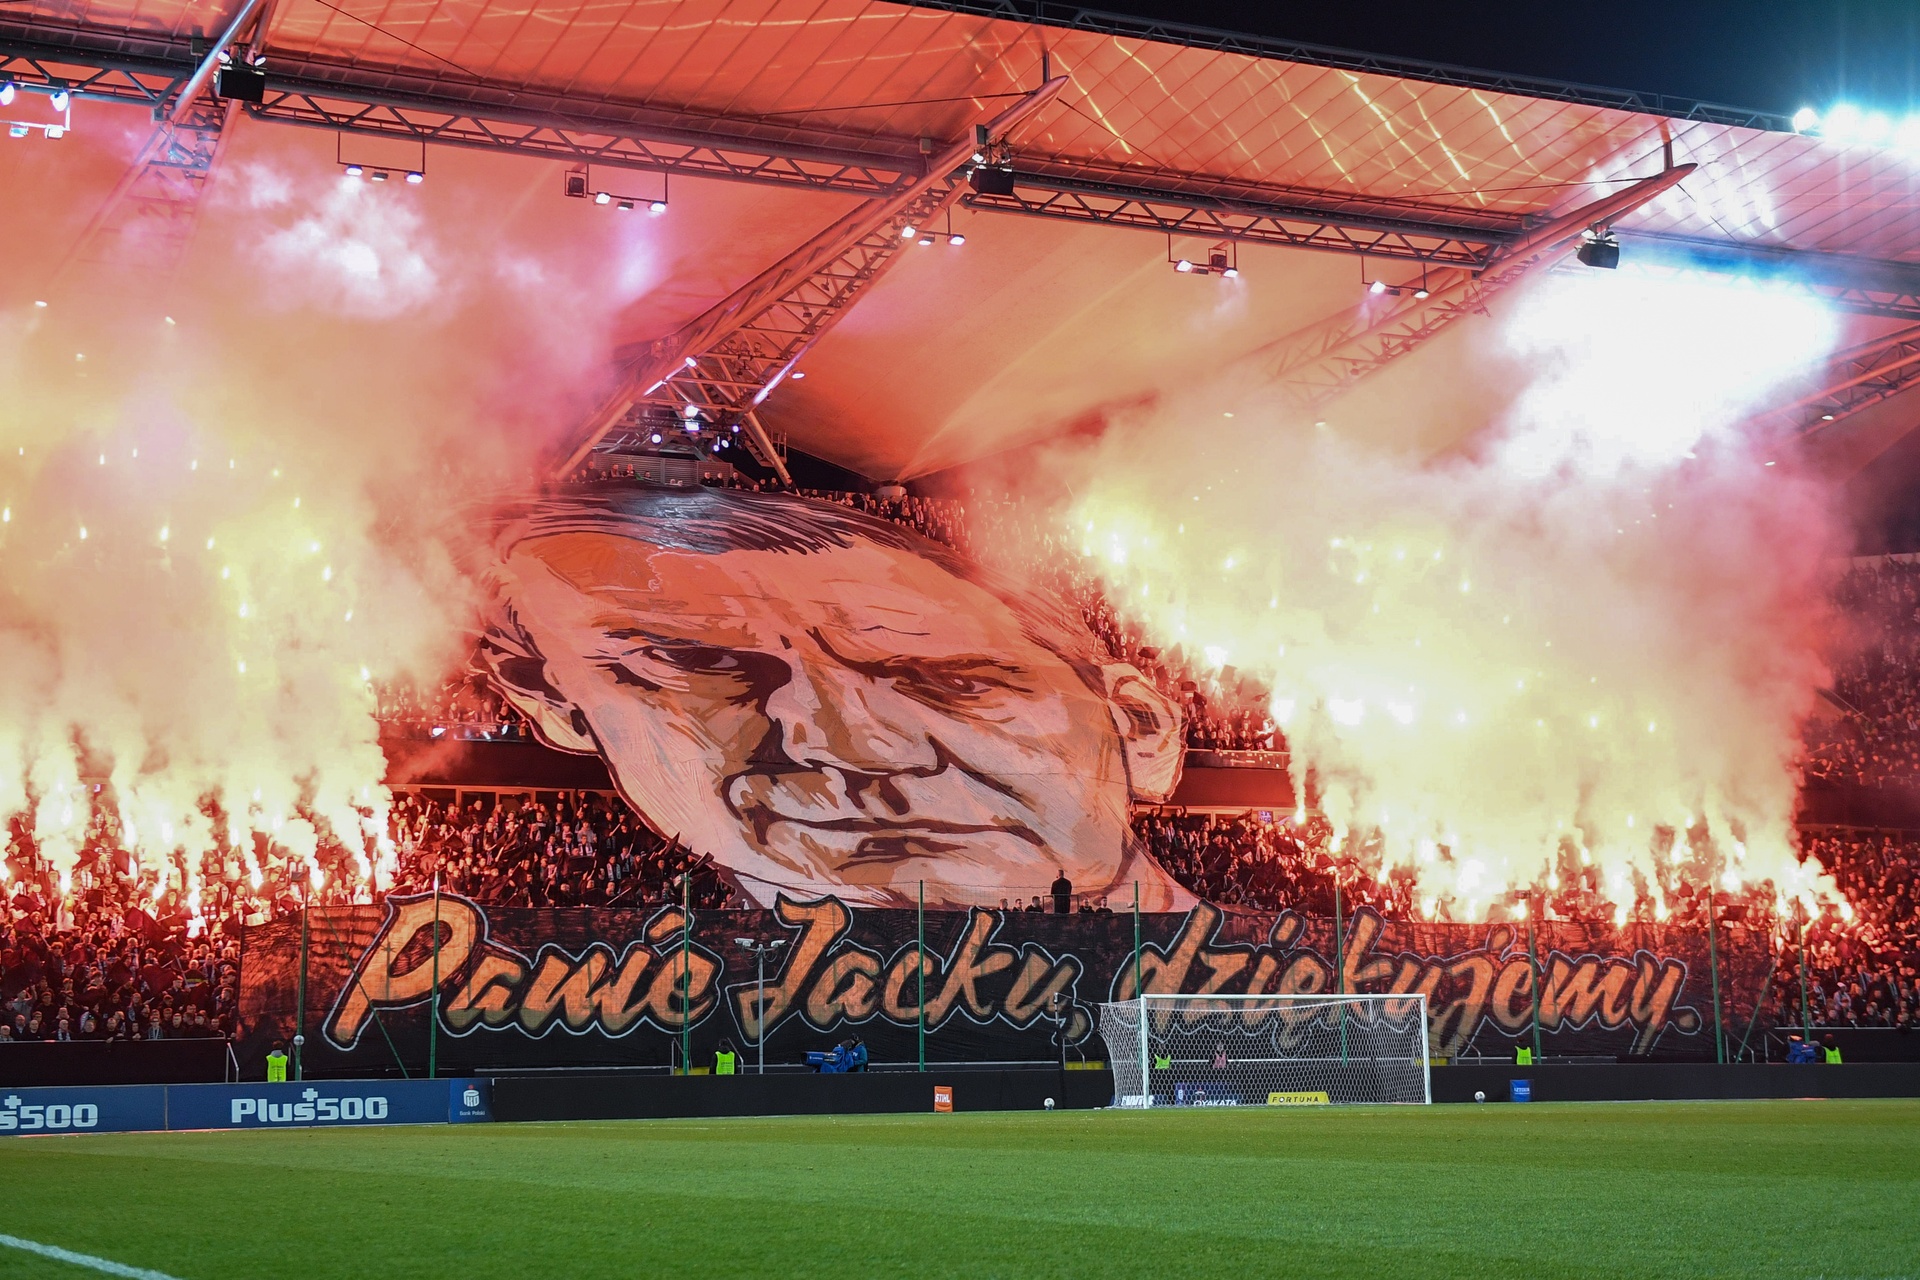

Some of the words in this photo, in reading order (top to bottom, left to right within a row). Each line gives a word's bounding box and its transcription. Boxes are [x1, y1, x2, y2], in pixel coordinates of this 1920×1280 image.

[325, 894, 722, 1048] Panie
[231, 1092, 388, 1123] Plus500
[934, 1094, 951, 1103] STIHL
